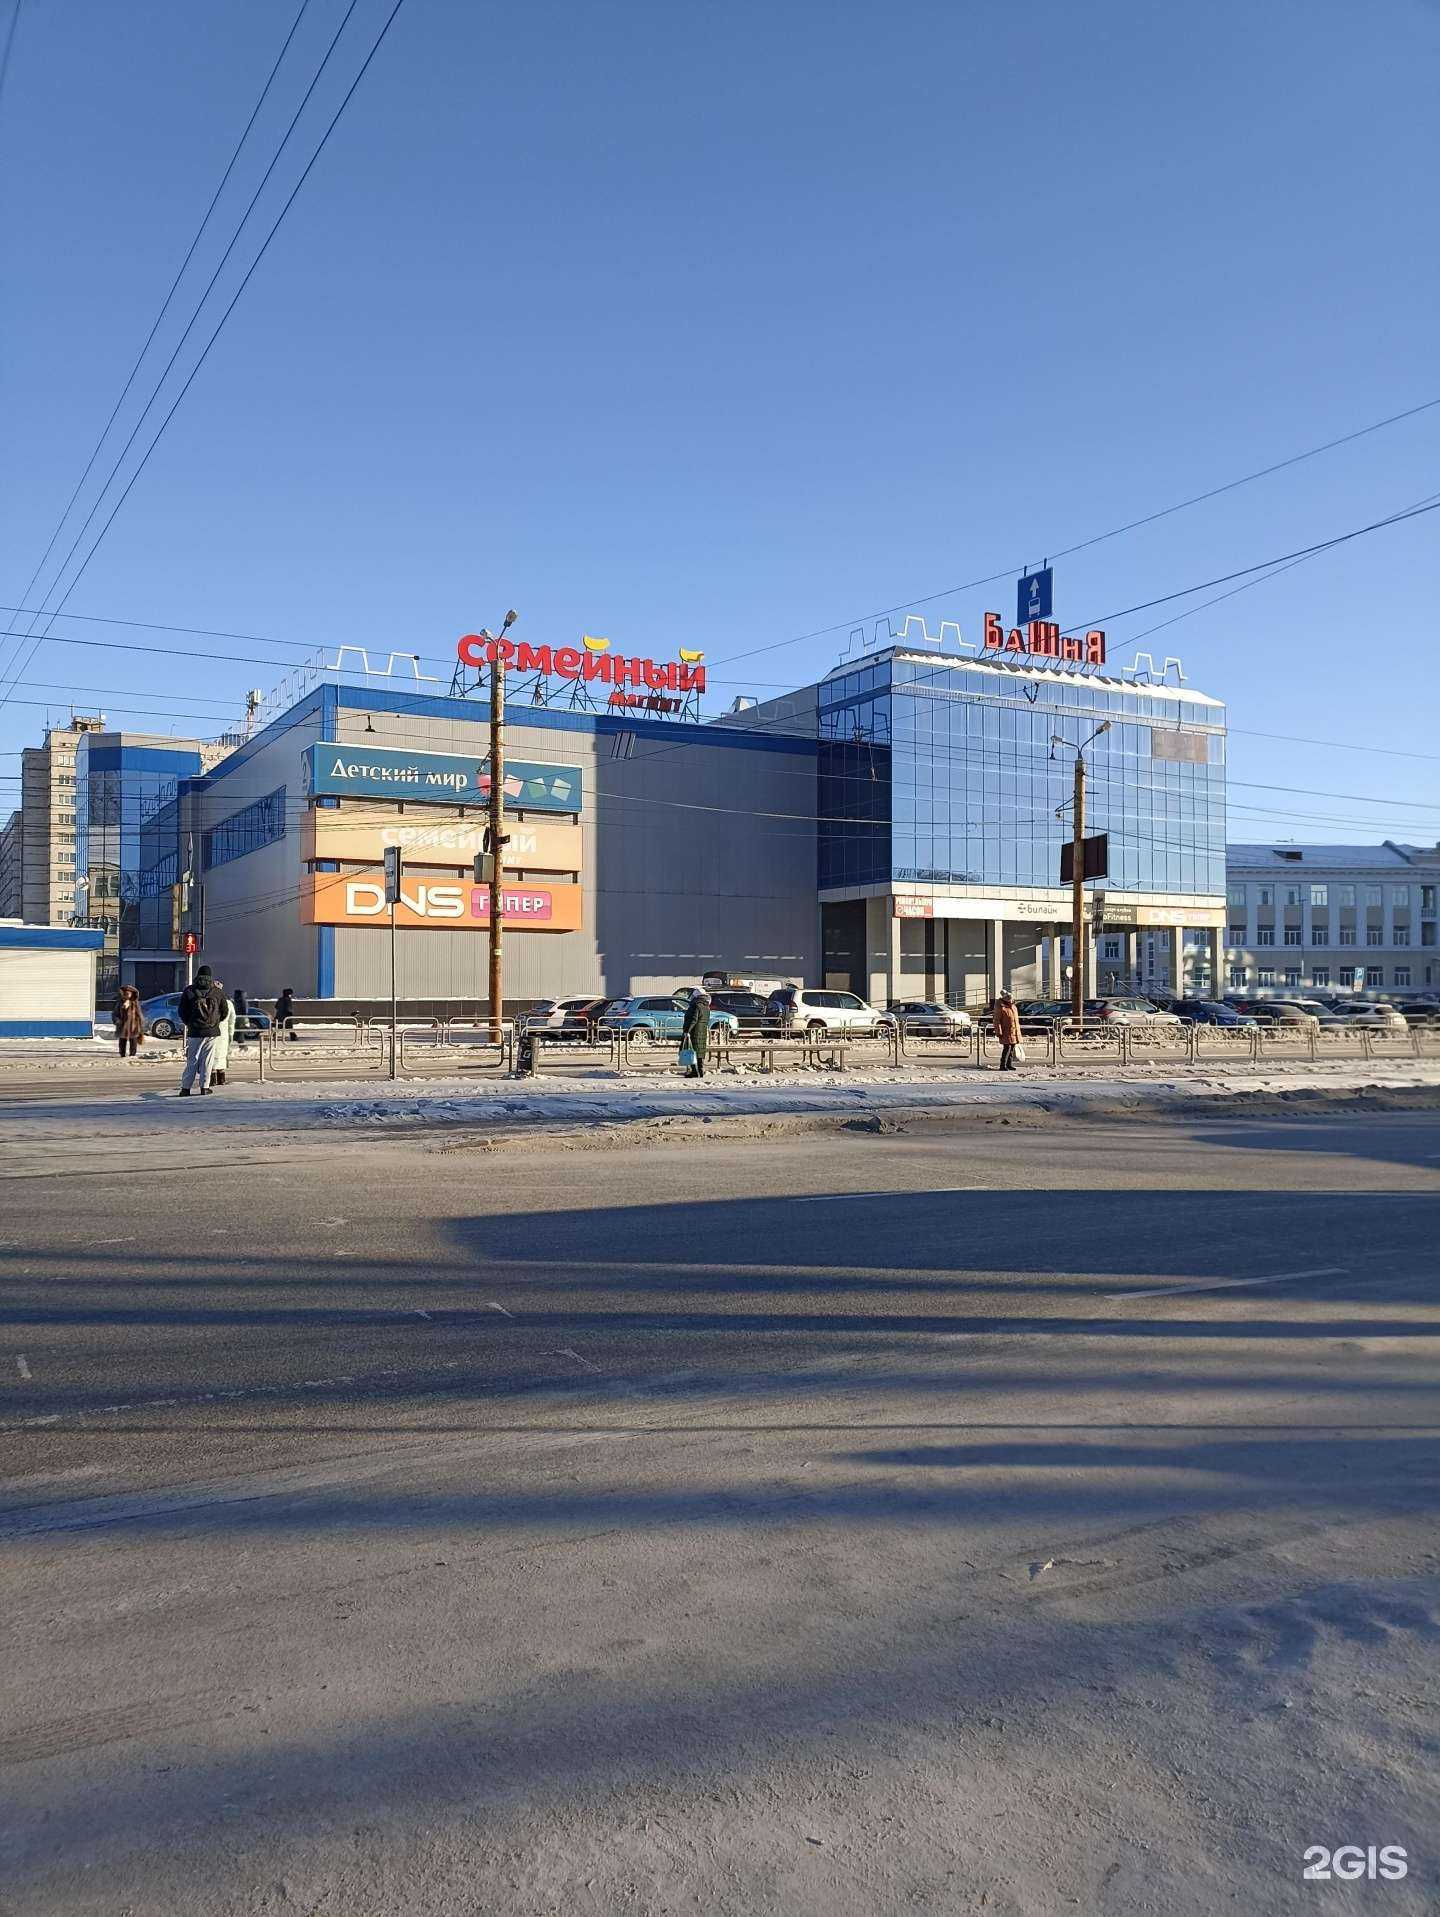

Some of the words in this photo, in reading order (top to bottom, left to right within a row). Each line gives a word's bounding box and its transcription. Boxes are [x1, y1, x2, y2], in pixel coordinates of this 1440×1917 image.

[330, 758, 419, 784] Детский
[426, 772, 468, 792] мир
[345, 881, 465, 919] DNS
[478, 895, 545, 912] ГПЕР
